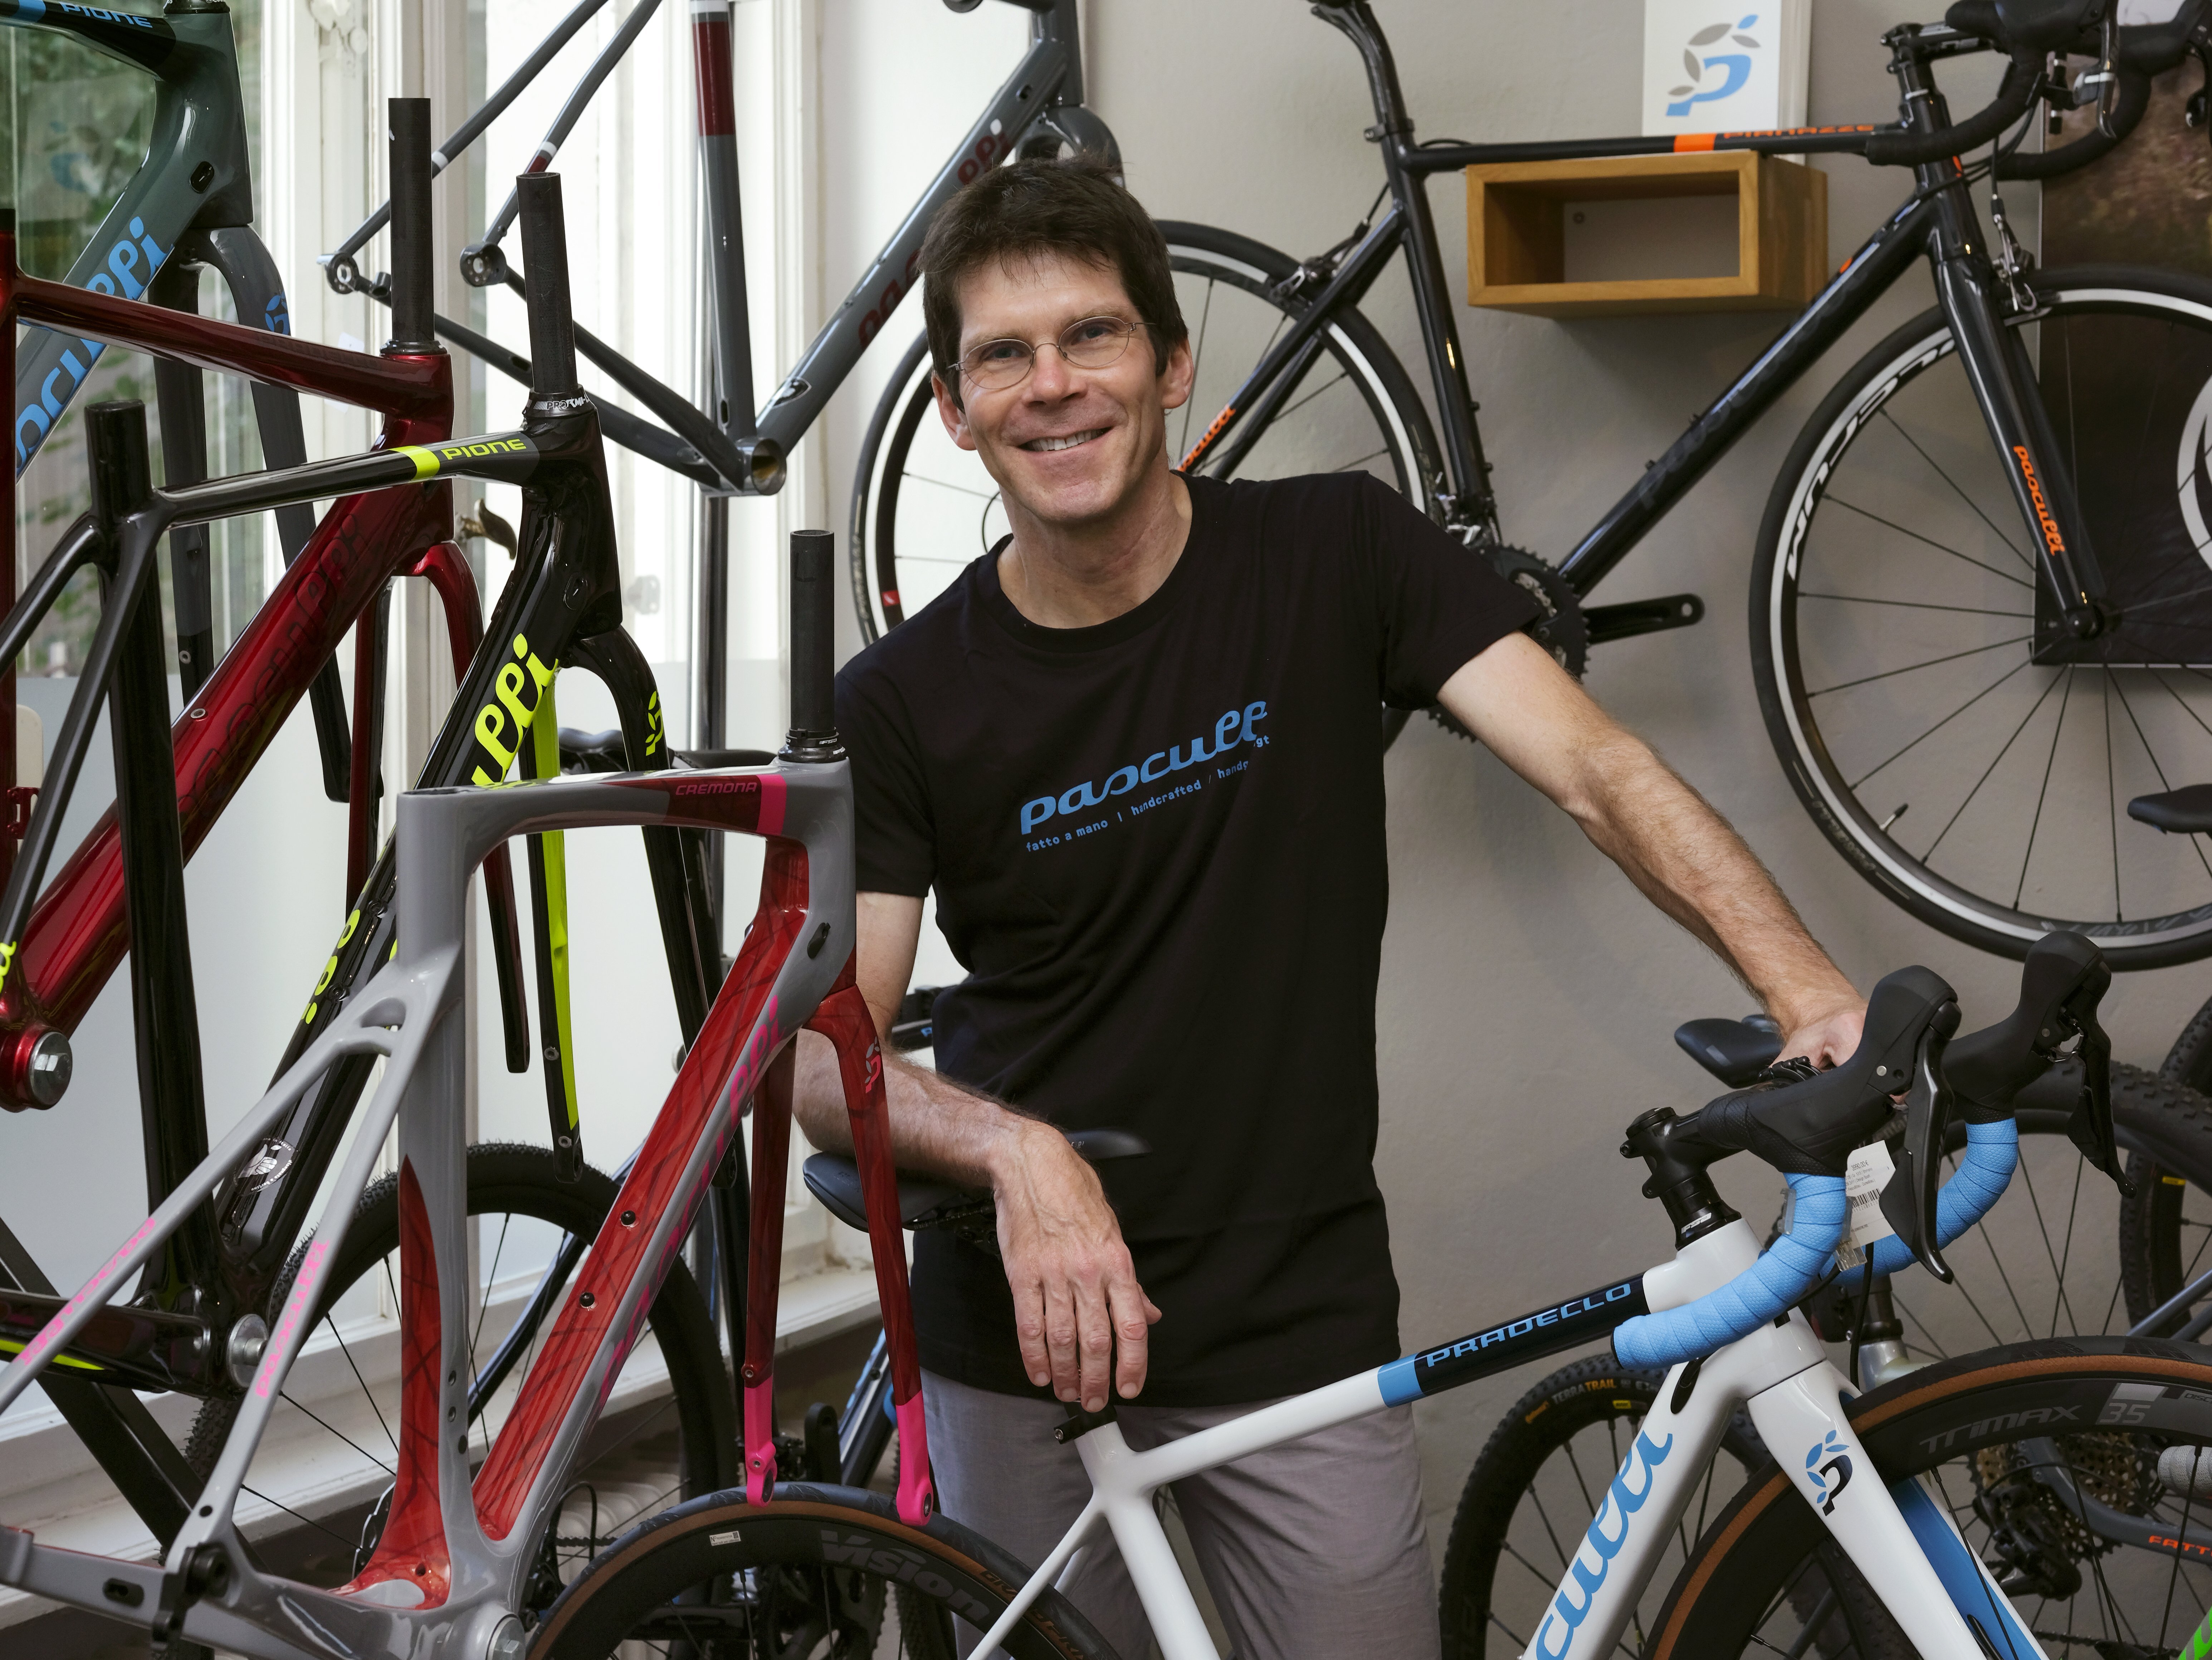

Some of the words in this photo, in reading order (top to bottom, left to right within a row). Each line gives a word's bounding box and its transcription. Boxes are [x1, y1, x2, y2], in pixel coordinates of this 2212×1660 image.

[59, 1, 153, 28] PIONE
[440, 439, 527, 460] PIONE
[2013, 446, 2065, 556] pasculli
[675, 782, 757, 795] CREMONA
[1026, 835, 1060, 852] fatto
[1065, 832, 1073, 841] a
[1076, 819, 1108, 837] mano
[1131, 779, 1202, 816] handcrafted
[1851, 1161, 1866, 1171] 3990,00
[251, 1180, 271, 1191] berlino
[255, 1239, 330, 1398] pasculli
[1427, 1284, 1631, 1368] PRADELLO
[1585, 1378, 1617, 1392] TRAIL
[2099, 1402, 2151, 1424] 35
[2148, 1535, 2212, 1557] FATT
